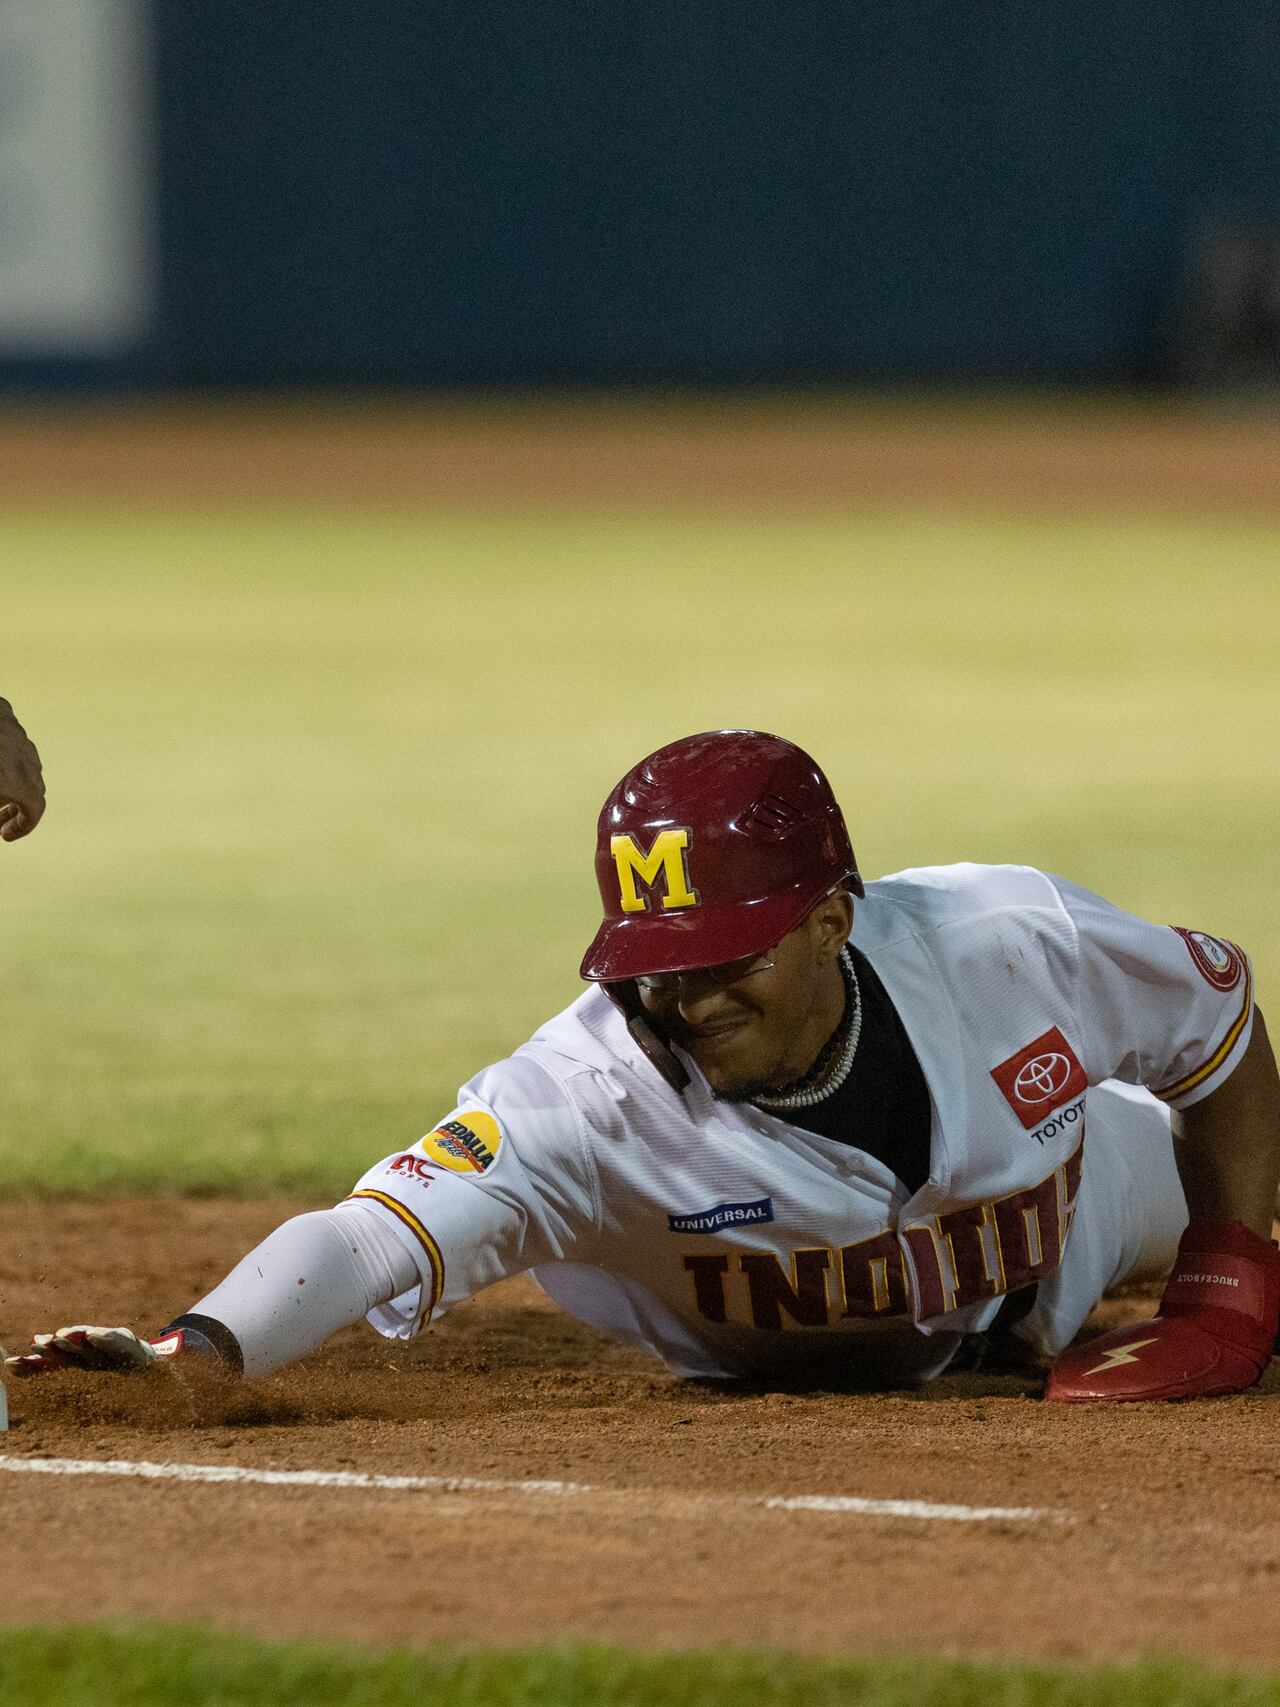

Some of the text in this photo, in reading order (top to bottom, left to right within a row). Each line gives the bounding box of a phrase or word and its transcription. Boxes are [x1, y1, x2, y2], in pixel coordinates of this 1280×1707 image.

[610, 829, 698, 913] M
[1031, 1099, 1085, 1145] TOYOT
[673, 1207, 767, 1229] UNIVERSAL
